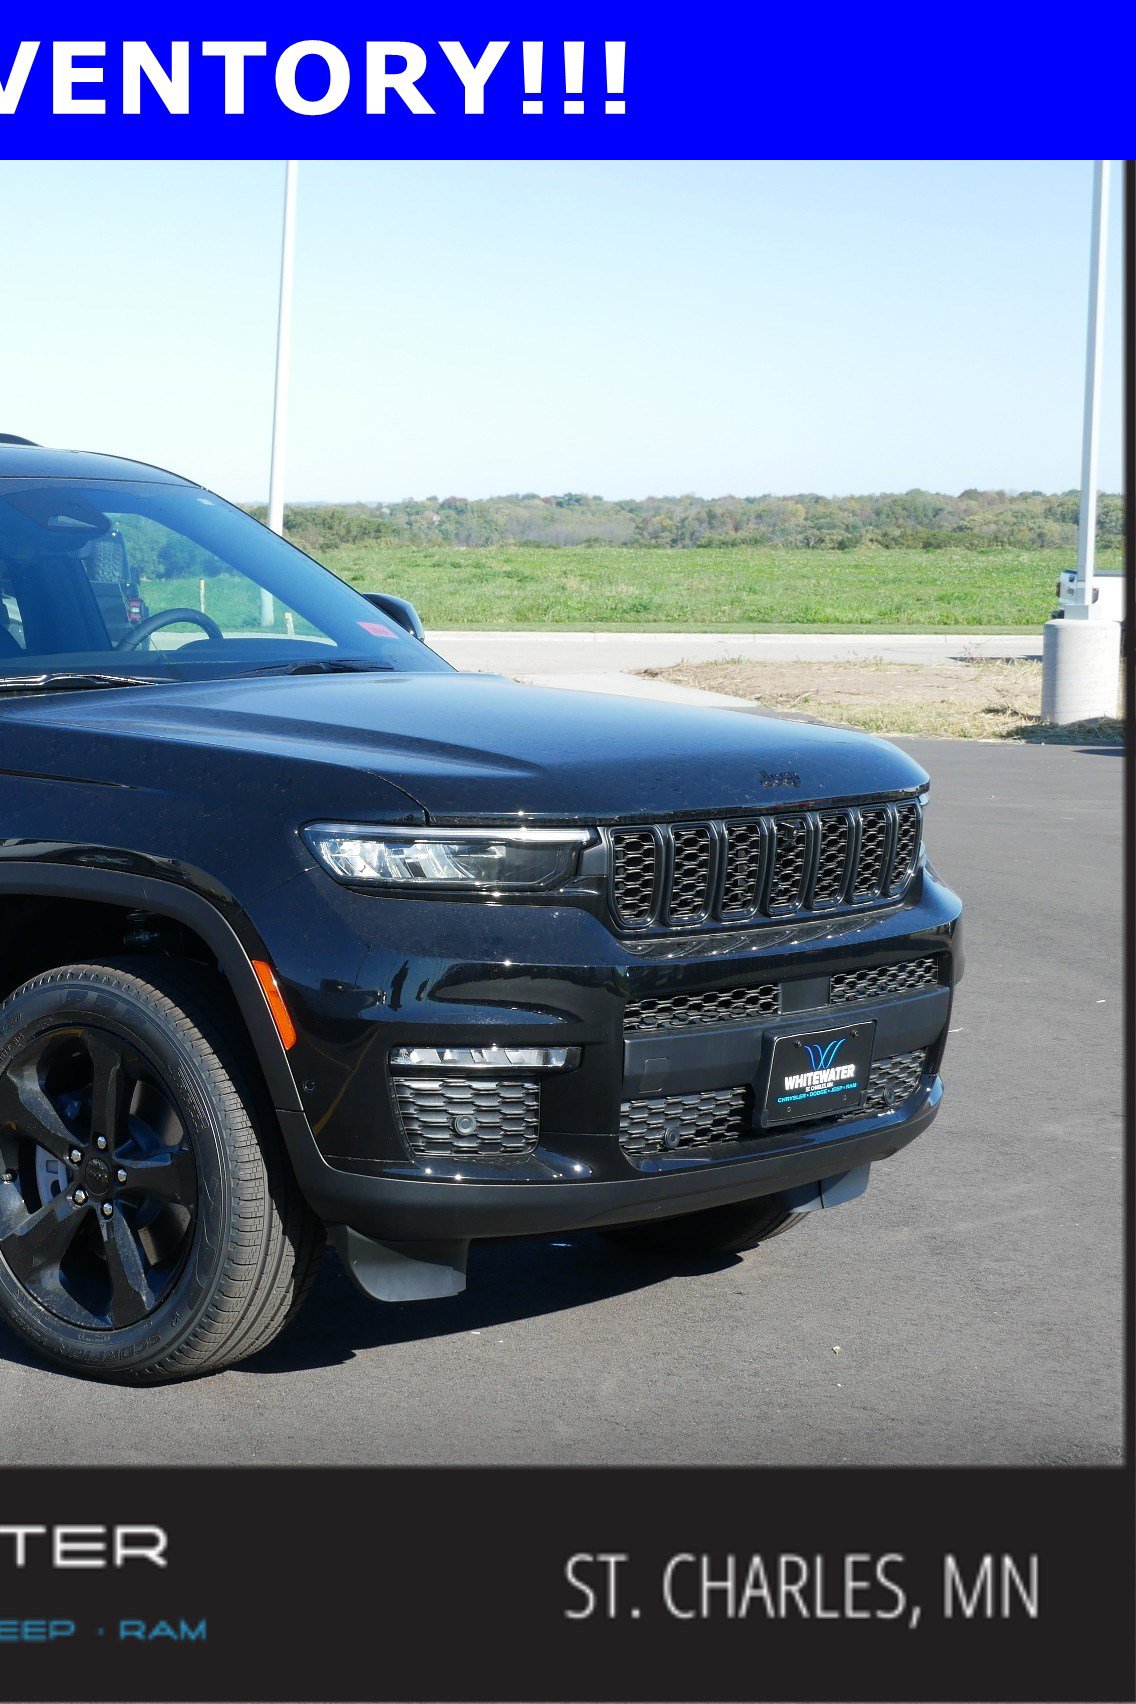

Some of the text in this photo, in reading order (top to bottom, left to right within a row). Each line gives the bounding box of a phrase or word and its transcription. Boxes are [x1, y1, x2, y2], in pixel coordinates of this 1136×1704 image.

[784, 1064, 856, 1091] WHITEWATER
[777, 1093, 807, 1103] CHRYSLER
[809, 1089, 828, 1098] DODGE
[845, 1082, 858, 1090] RAM
